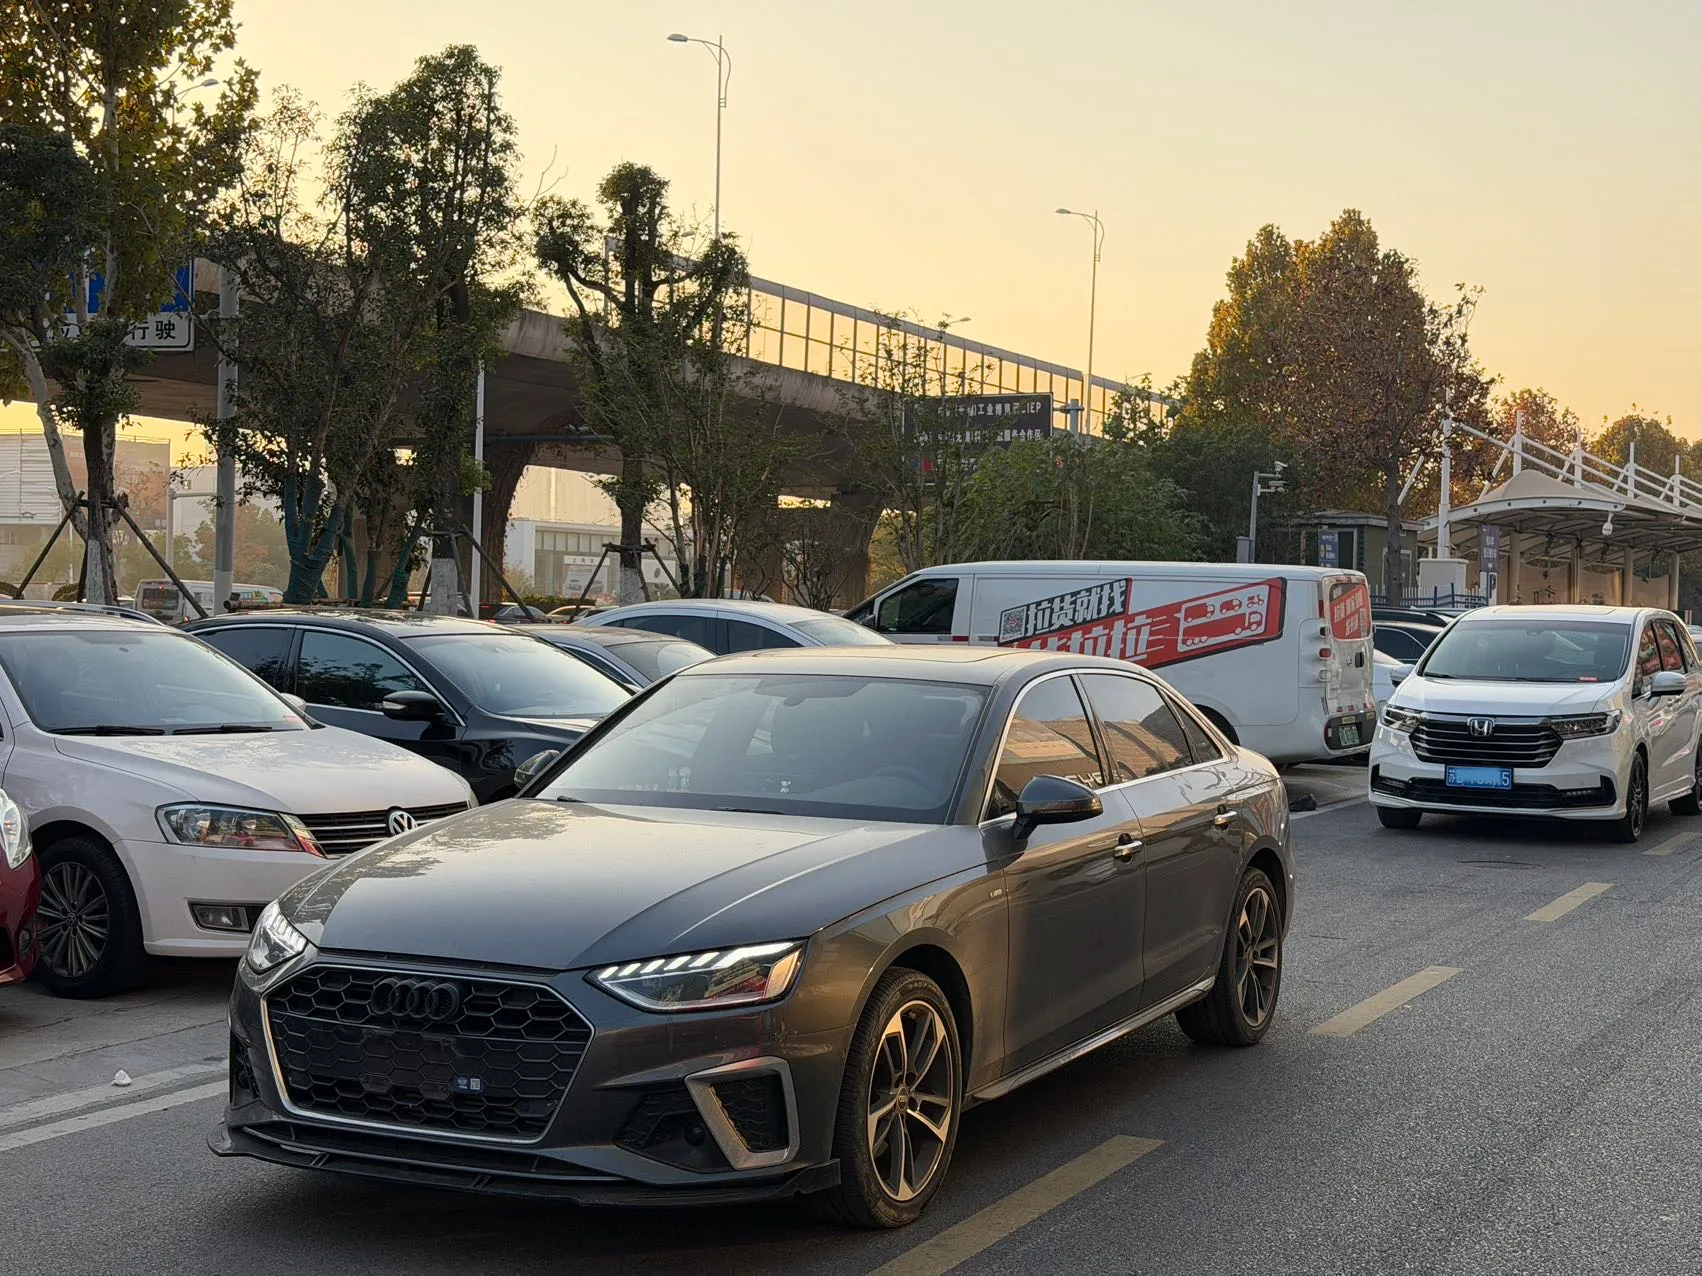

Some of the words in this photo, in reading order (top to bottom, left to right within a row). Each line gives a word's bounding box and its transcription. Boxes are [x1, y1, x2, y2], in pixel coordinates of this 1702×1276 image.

[130, 320, 176, 340] 行驶
[1025, 580, 1127, 637] 拉货就找
